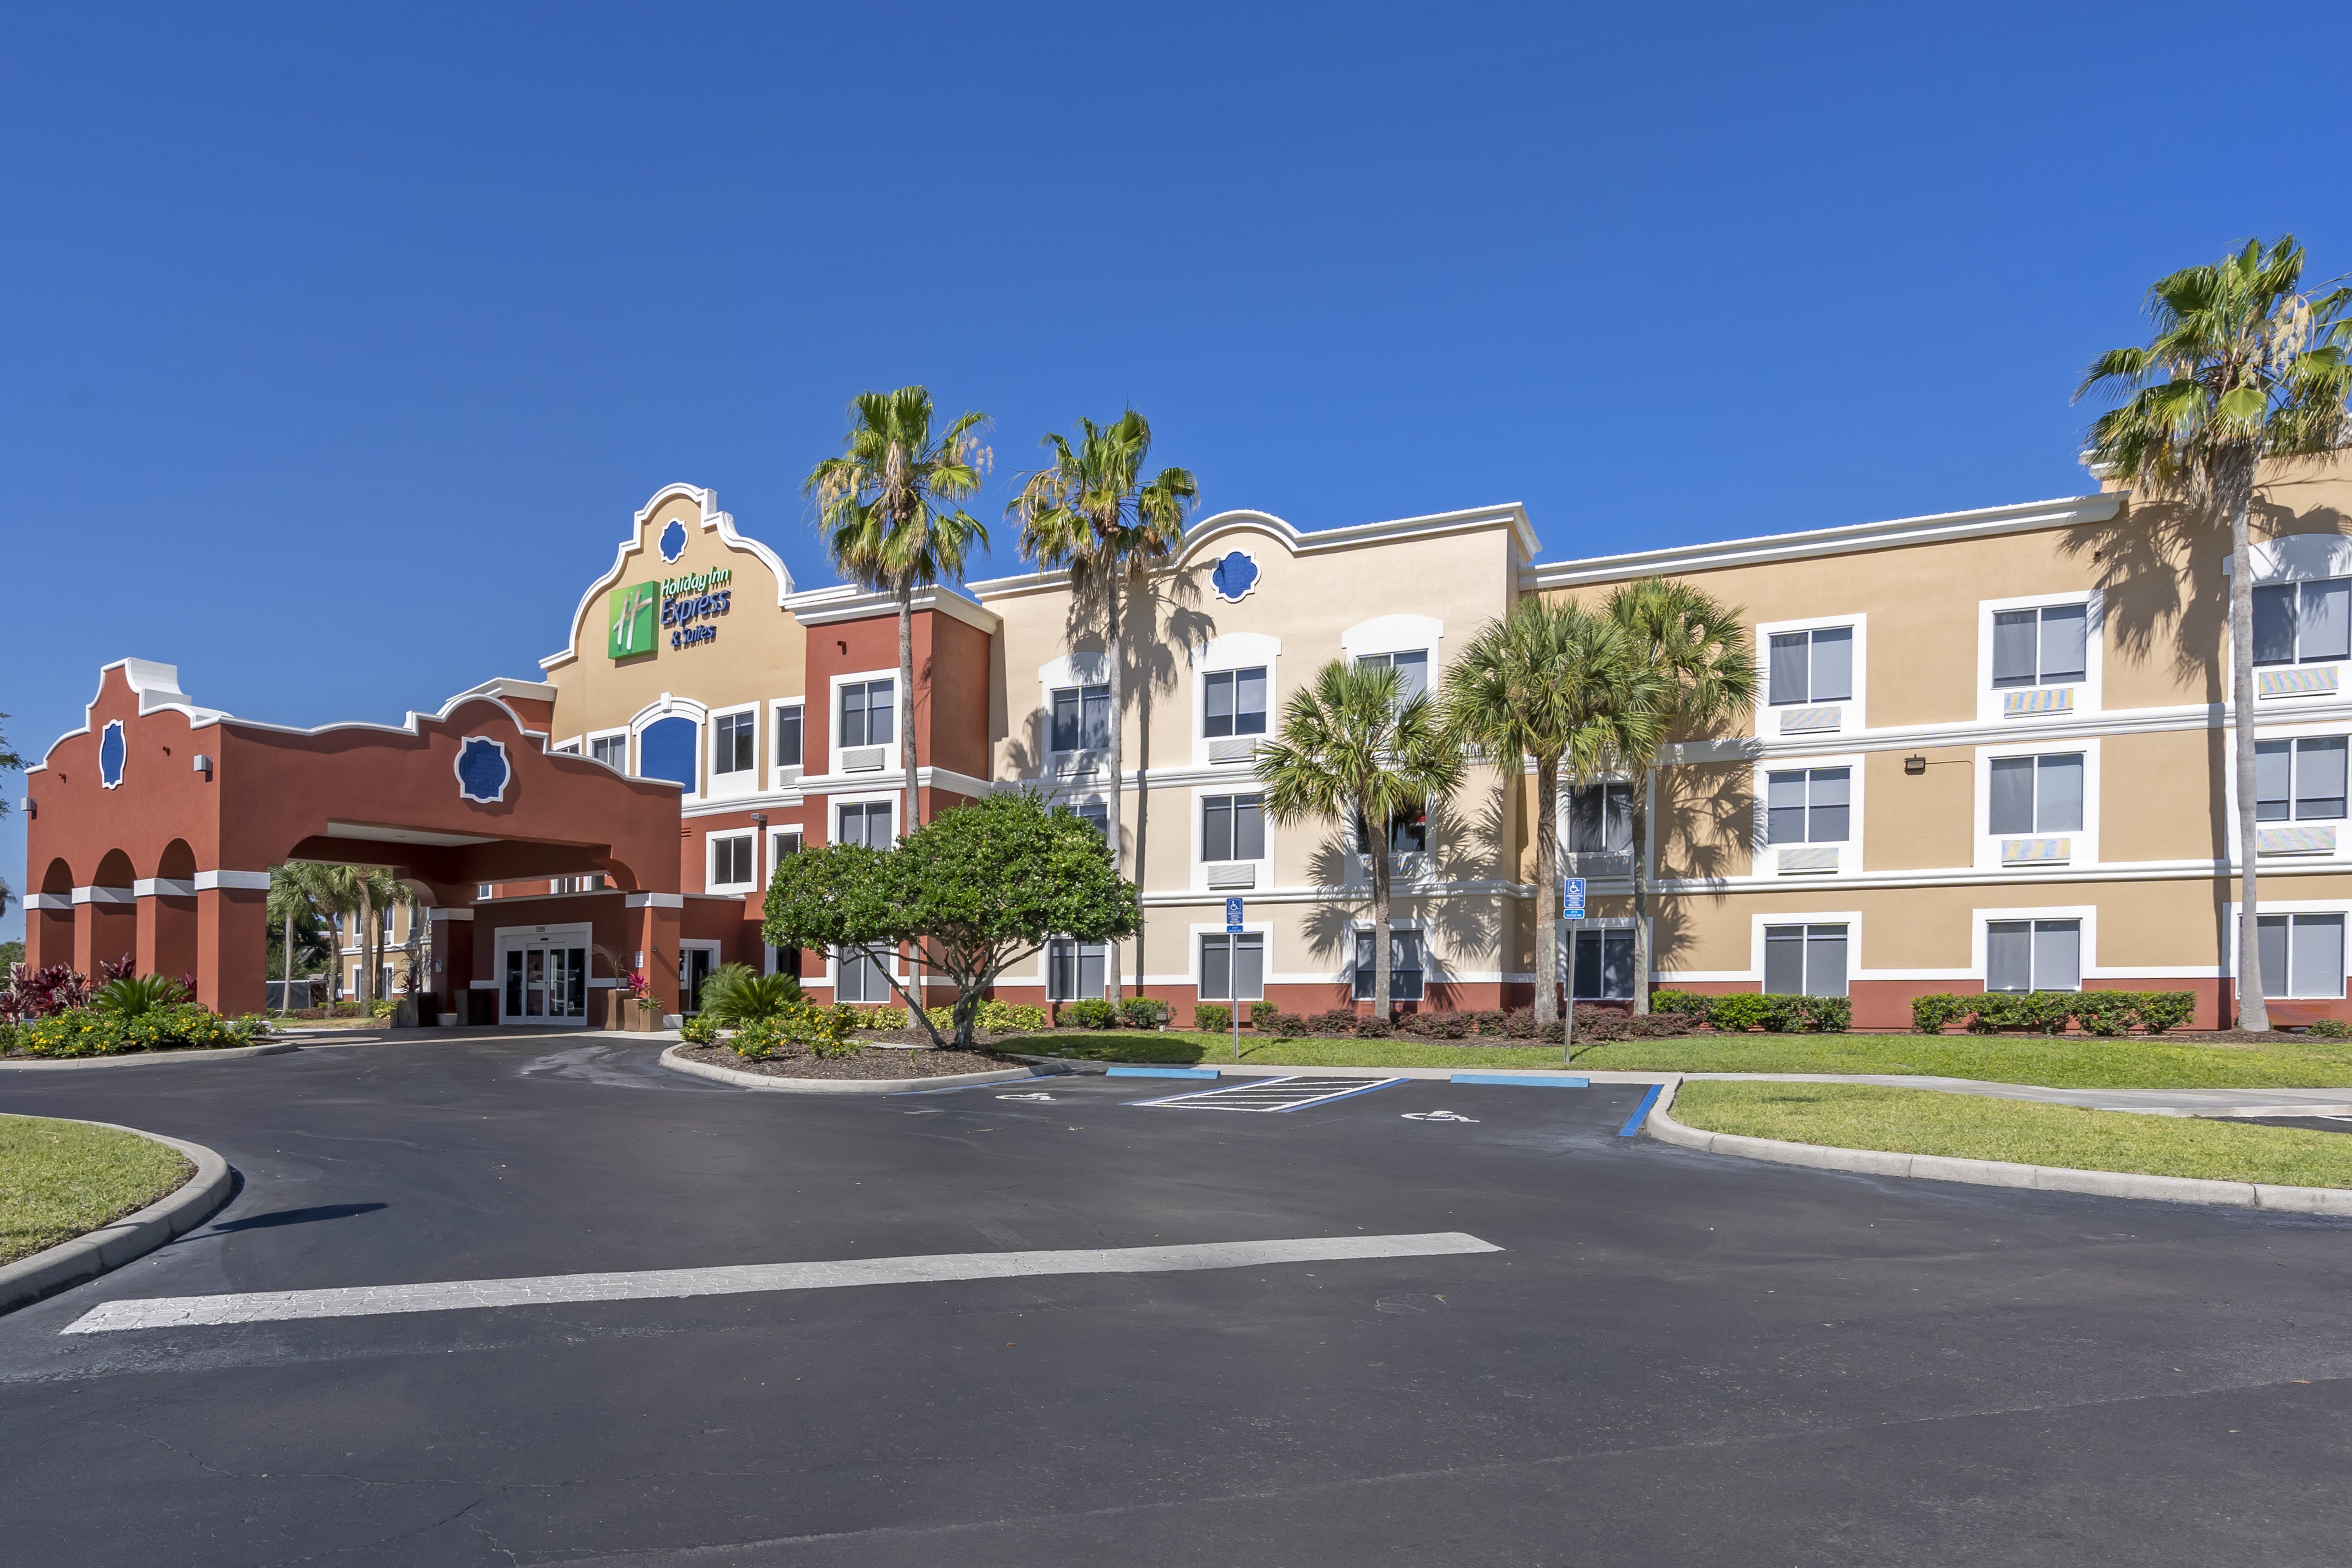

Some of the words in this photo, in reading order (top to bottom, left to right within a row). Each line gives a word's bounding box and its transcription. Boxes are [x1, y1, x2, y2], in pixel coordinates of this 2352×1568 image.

[661, 572, 708, 597] Holiday
[708, 566, 731, 584] Inn
[661, 590, 730, 627] Express
[670, 630, 681, 646] &
[681, 625, 716, 643] Suites
